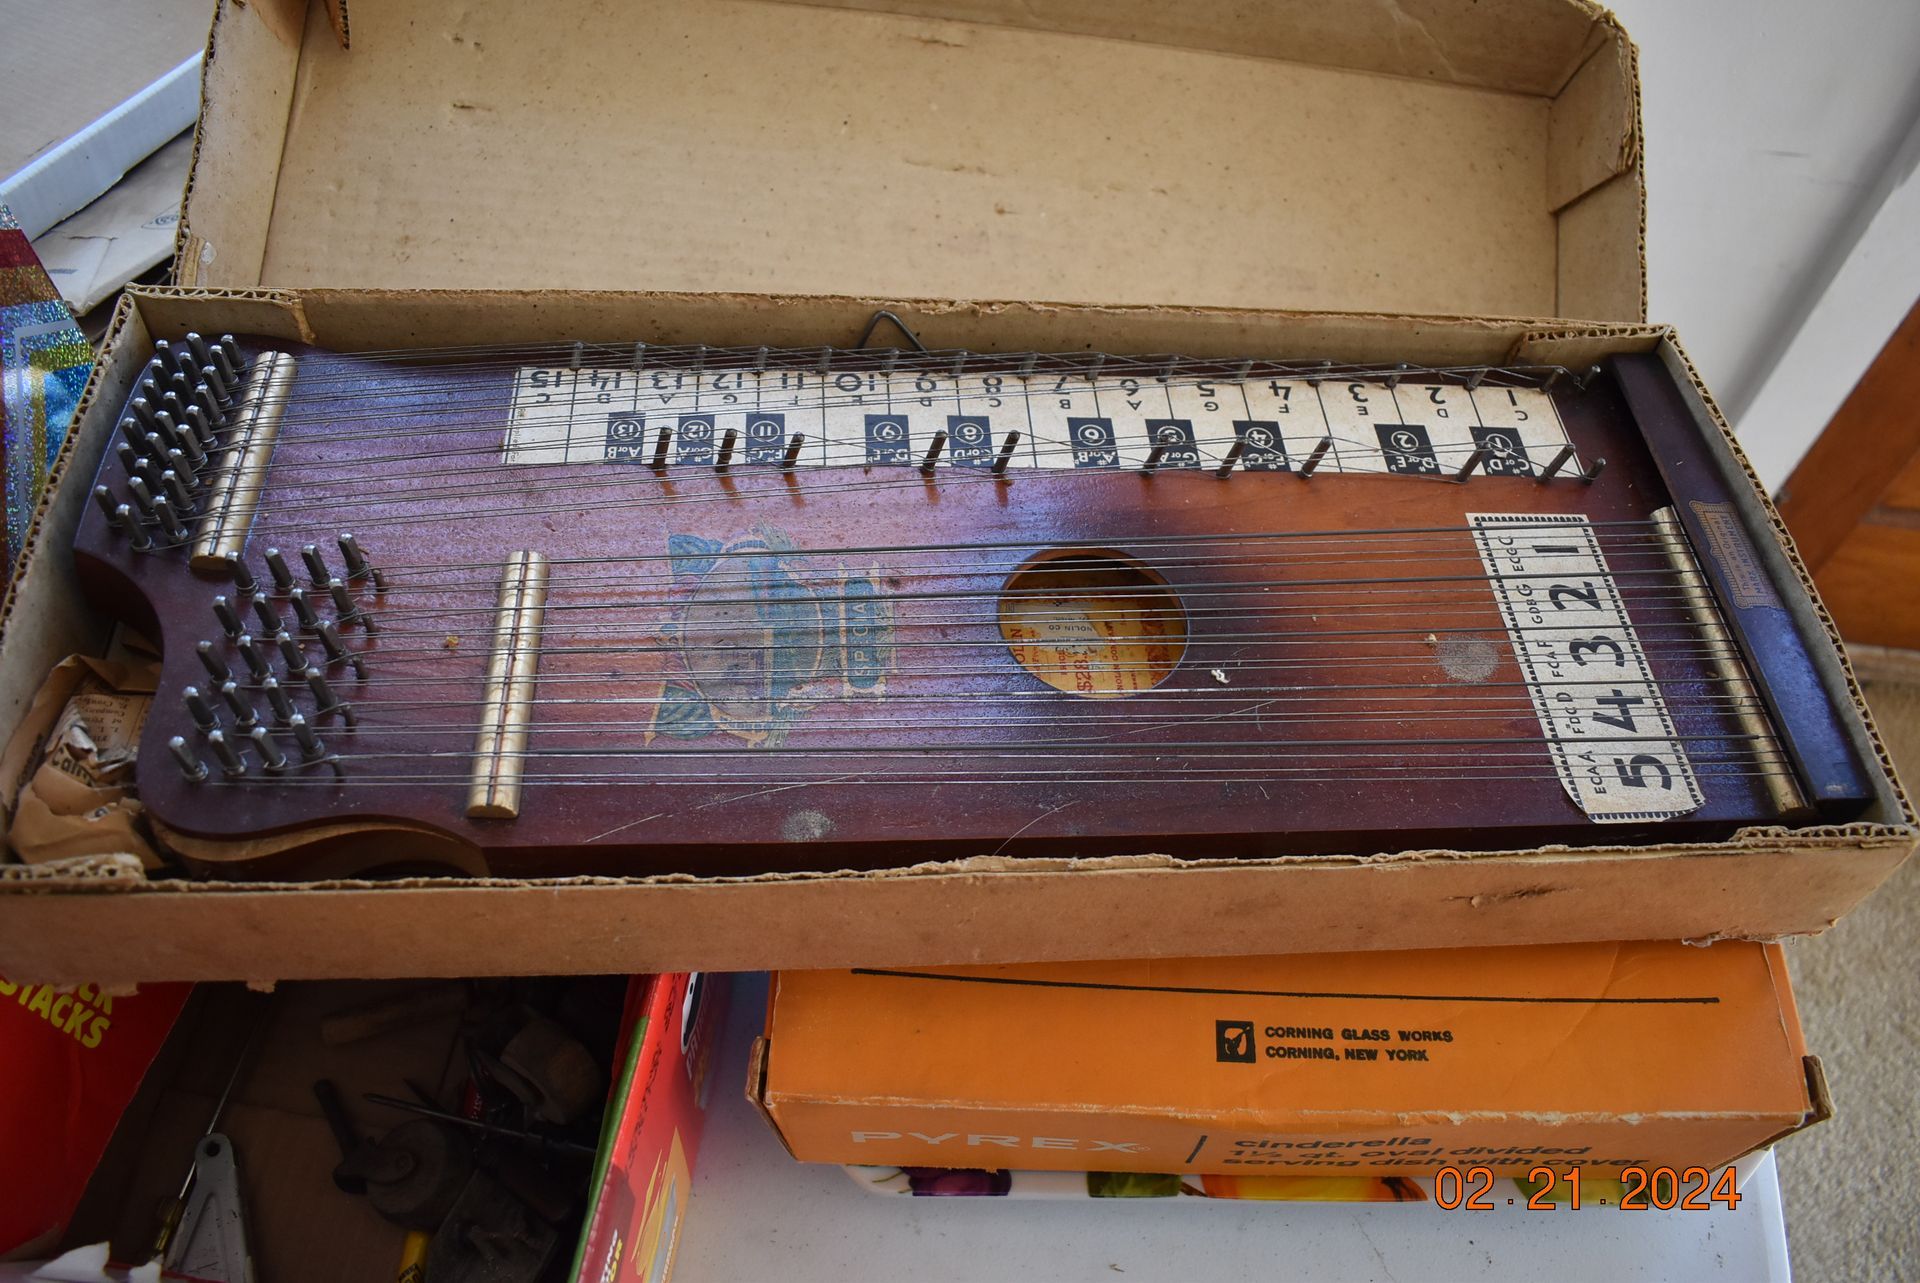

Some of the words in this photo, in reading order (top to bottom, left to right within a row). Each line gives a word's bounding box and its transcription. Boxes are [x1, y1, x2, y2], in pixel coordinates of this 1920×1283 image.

[530, 370, 562, 389] 15
[591, 369, 622, 390] 14
[652, 371, 682, 390] 13
[713, 372, 742, 390] 12
[782, 372, 803, 390] 11
[835, 372, 875, 392] 10
[916, 371, 937, 393] 9
[982, 374, 1003, 394] 8
[1054, 376, 1071, 395] 7
[1120, 378, 1139, 396] 6
[1197, 380, 1216, 397] 5
[1269, 381, 1292, 400] 4
[1348, 383, 1368, 403] 3
[1425, 387, 1446, 404] 2
[1059, 399, 1071, 410] B
[1126, 399, 1142, 411] A
[1506, 389, 1518, 406] 1
[1204, 402, 1219, 412] G
[1279, 403, 1290, 414] F
[1357, 405, 1368, 416] E
[1437, 408, 1449, 418] D
[1515, 410, 1528, 421] C
[1531, 545, 1580, 554] 1
[1548, 581, 1604, 612] 2
[1569, 635, 1625, 668] 3
[1592, 689, 1645, 733] 4
[1613, 754, 1672, 791] 5
[1265, 1026, 1334, 1040] CORNING
[1341, 1028, 1391, 1042] GLASS
[1398, 1030, 1454, 1043] WORKS
[1265, 1045, 1340, 1061] CORNING,
[1344, 1048, 1378, 1061] NEW
[1385, 1049, 1430, 1062] YORK
[1234, 1137, 1433, 1149] cinderella
[1360, 1147, 1444, 1158] oval
[1449, 1145, 1593, 1156] divided
[1223, 1158, 1361, 1167] serving
[1369, 1157, 1448, 1166] dish
[1457, 1157, 1534, 1166] with
[1541, 1158, 1651, 1167] cover
